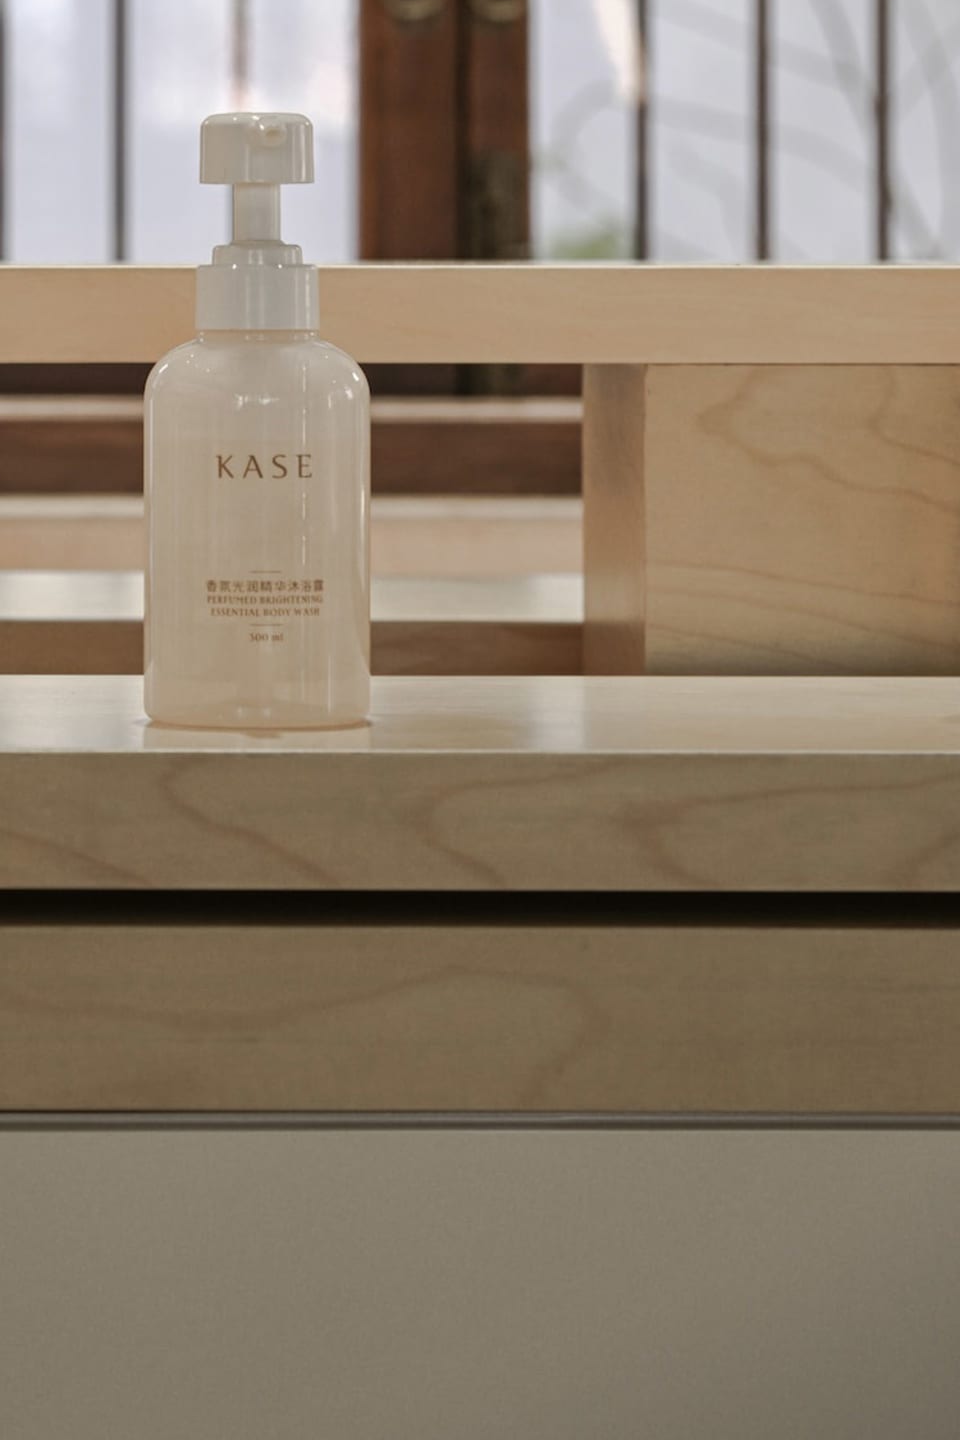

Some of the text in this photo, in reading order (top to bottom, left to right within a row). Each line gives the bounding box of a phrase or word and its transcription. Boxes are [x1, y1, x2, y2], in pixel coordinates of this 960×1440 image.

[215, 454, 313, 479] KASE
[207, 595, 323, 604] PERFUMED BRIGHTENING
[210, 607, 320, 617] ESSENTIAL BODY WASH
